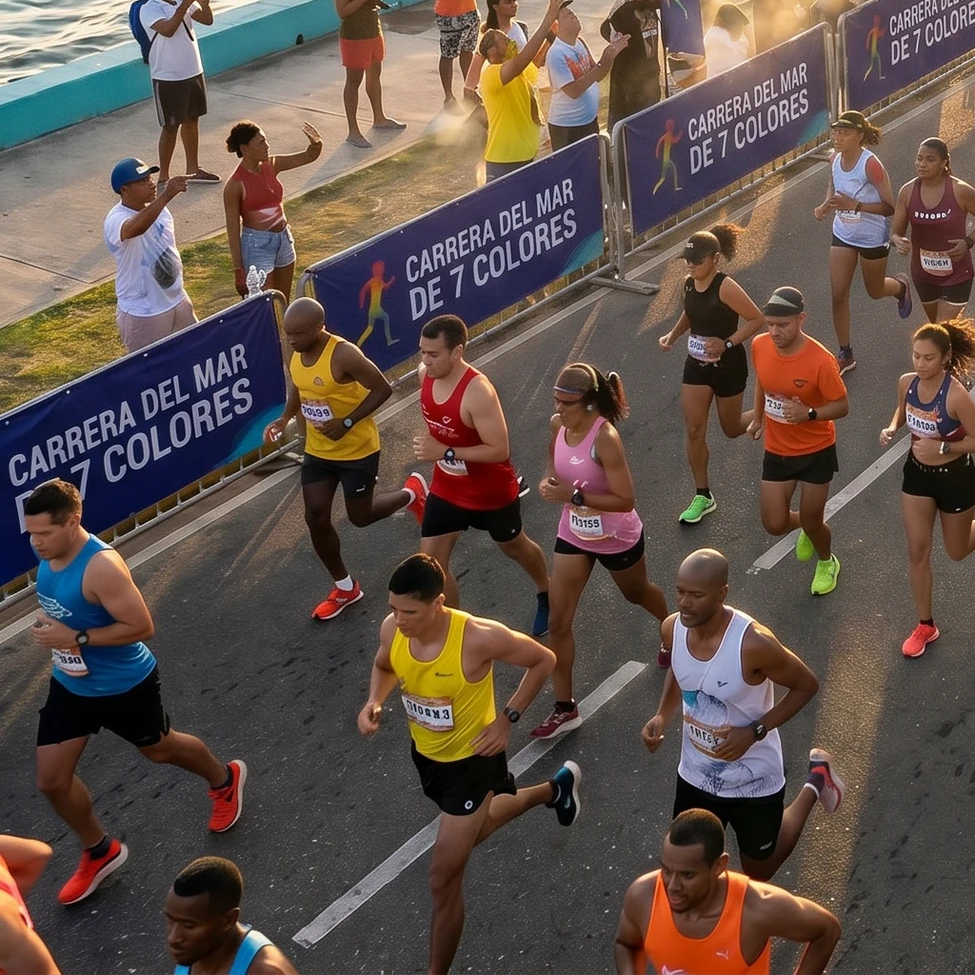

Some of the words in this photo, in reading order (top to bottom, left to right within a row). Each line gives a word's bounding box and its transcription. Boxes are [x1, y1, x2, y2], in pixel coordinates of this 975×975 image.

[891, 34, 910, 66] DE
[913, 28, 921, 54] 7
[688, 91, 752, 141] CARRERA
[754, 78, 778, 108] DEL
[780, 62, 808, 94] MAR
[689, 137, 714, 175] DE
[718, 129, 728, 158] 7
[734, 88, 809, 149] COLORES
[405, 219, 496, 283] CARRERA
[499, 200, 533, 237] DEL
[535, 178, 574, 218] MAR
[409, 276, 444, 321] DE
[450, 264, 465, 299] 7
[472, 208, 577, 287] COLORES
[8, 401, 136, 487] CARRERA
[140, 375, 190, 421] DEL
[193, 343, 248, 394] MAR
[70, 459, 91, 502] 7
[103, 377, 253, 483] COLORES
